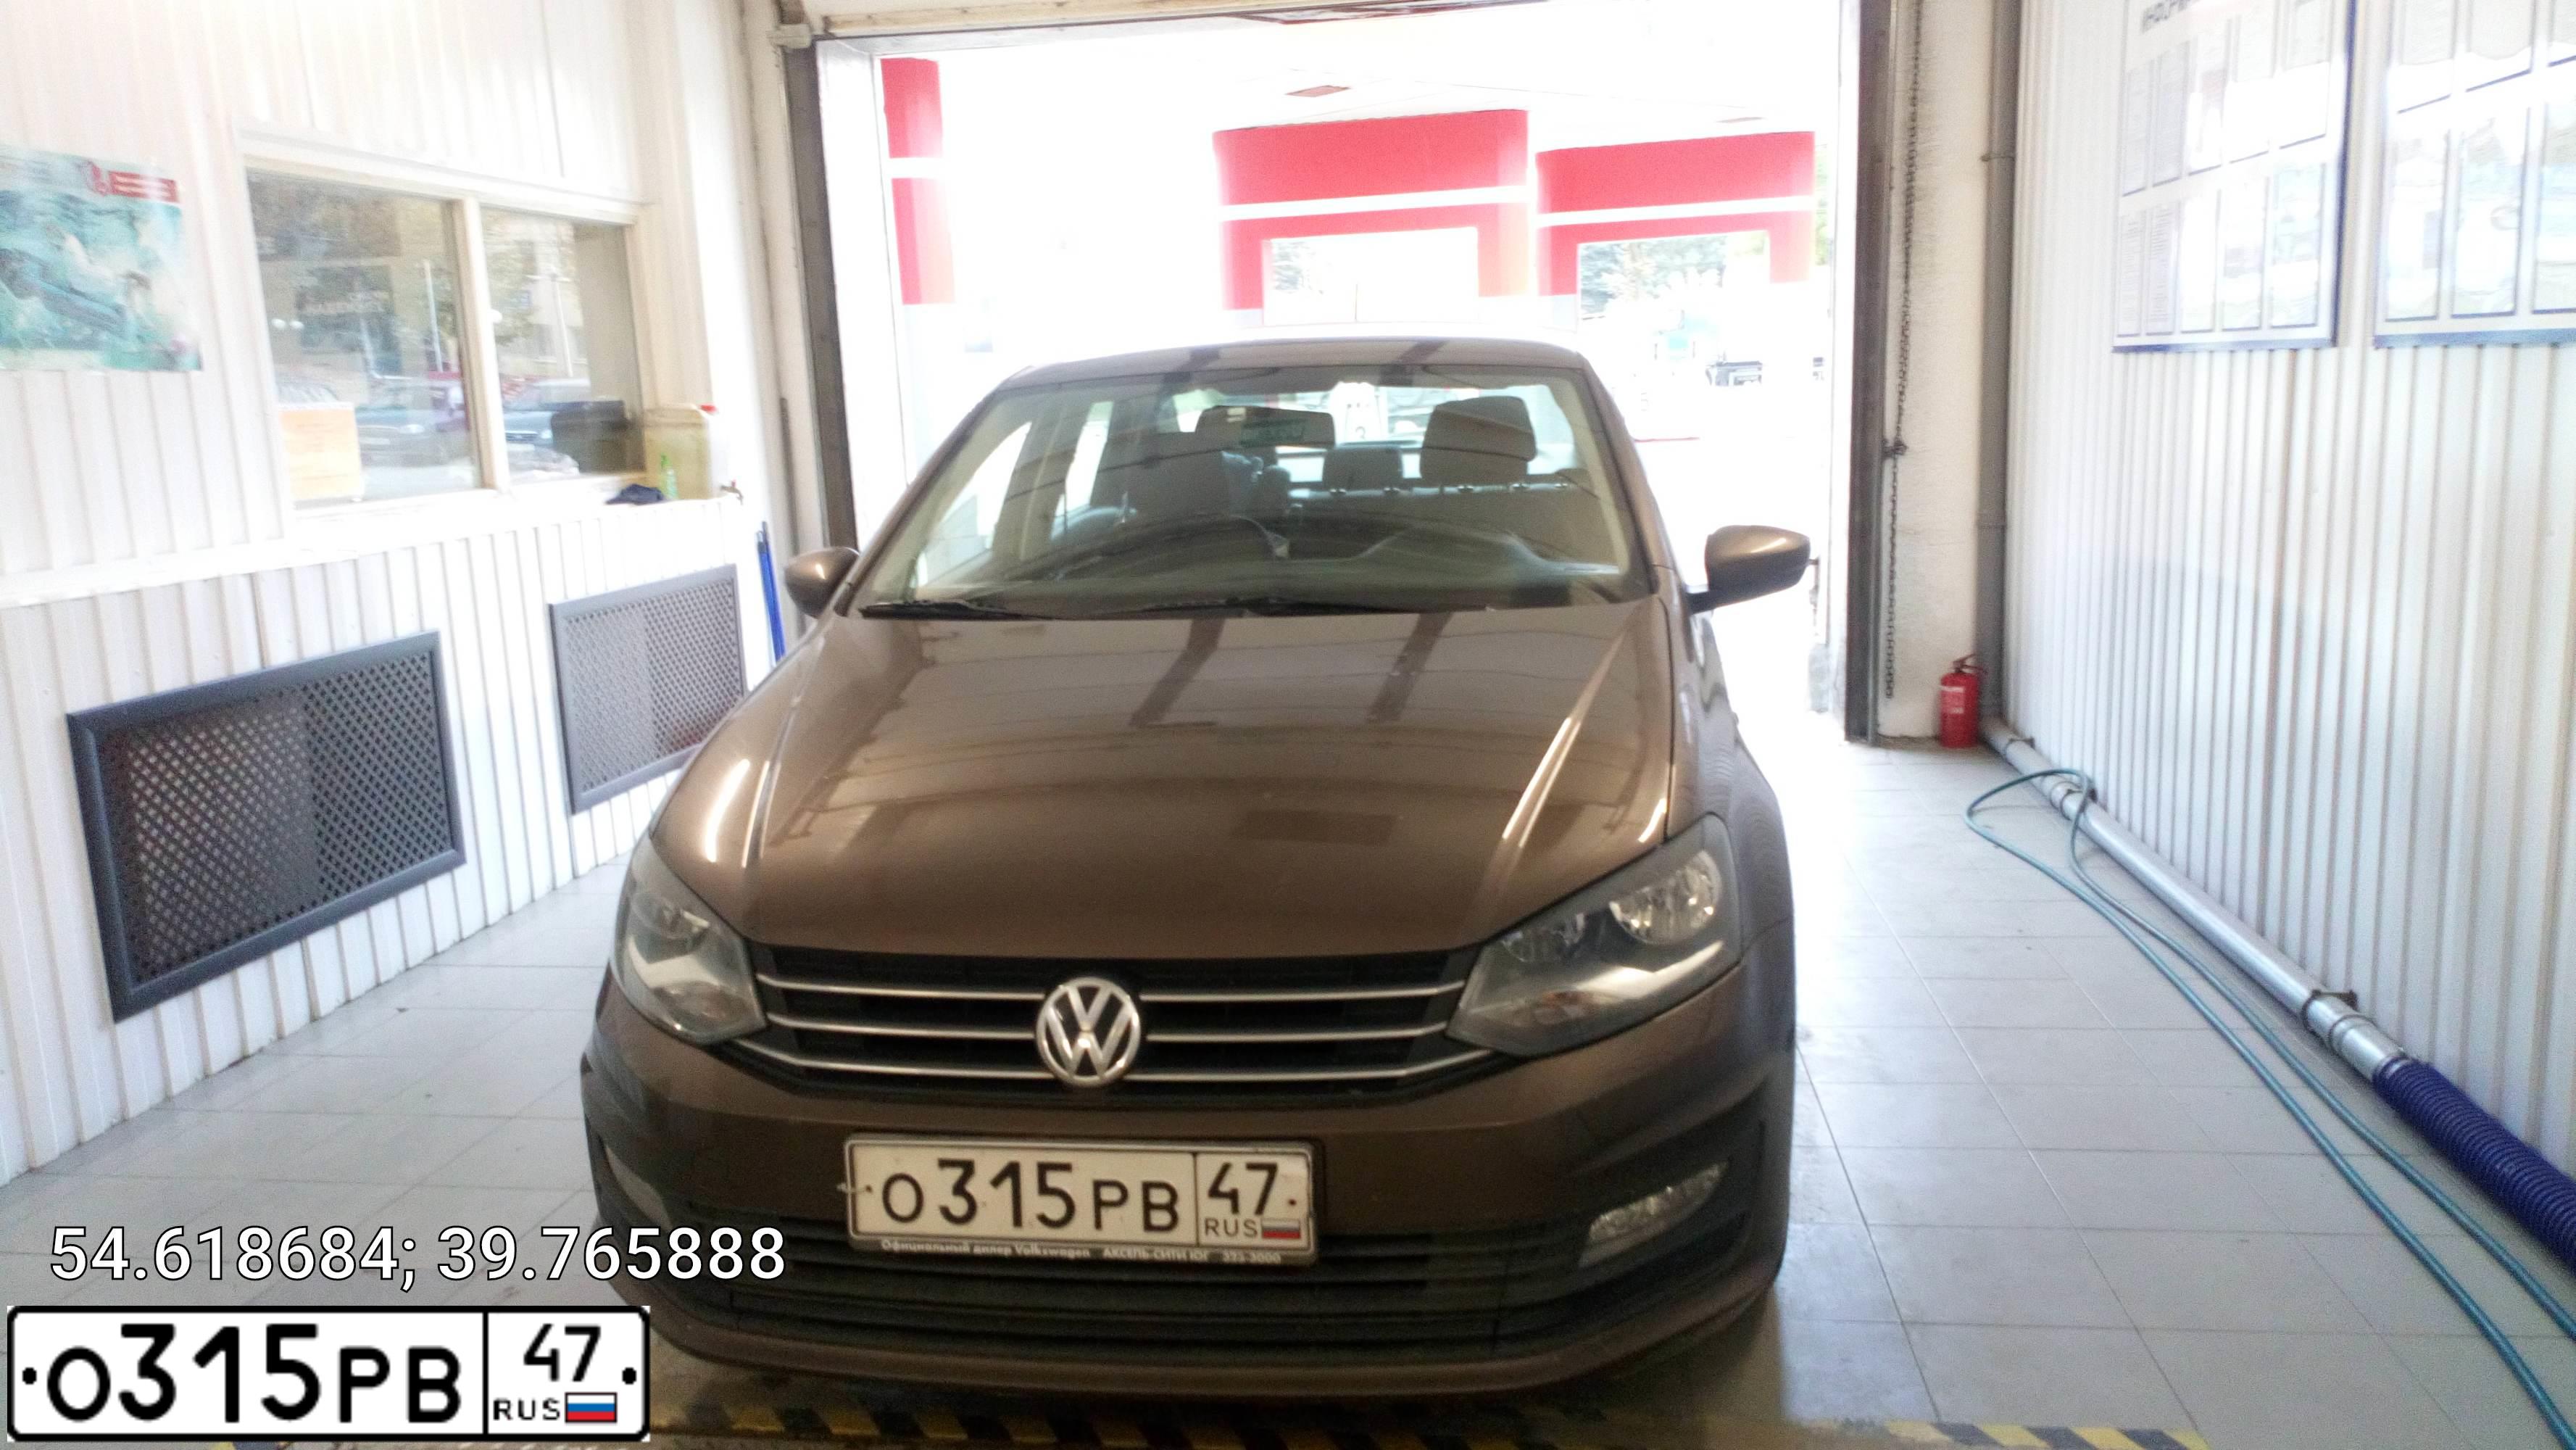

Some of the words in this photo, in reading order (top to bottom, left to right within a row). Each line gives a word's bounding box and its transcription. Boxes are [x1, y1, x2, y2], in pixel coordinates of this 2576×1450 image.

[1207, 1161, 1279, 1216] 47
[1203, 1218, 1258, 1237] RUS
[1014, 1242, 1091, 1259] Volkswagen
